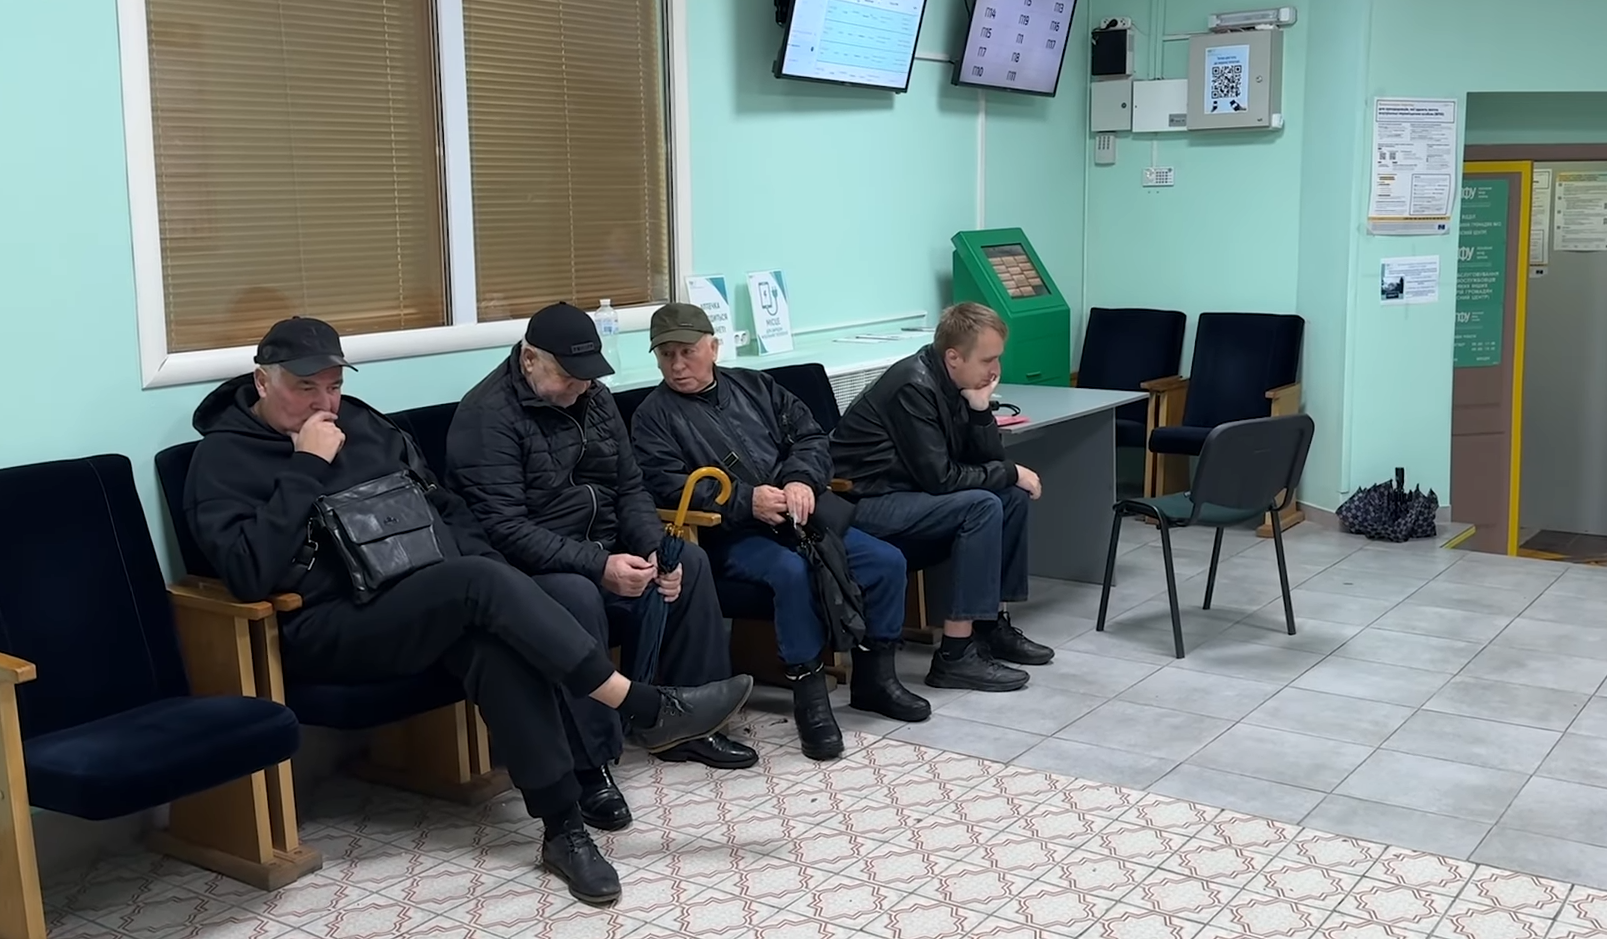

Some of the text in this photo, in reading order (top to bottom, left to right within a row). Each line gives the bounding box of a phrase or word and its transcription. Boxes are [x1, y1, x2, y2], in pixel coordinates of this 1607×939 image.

[984, 7, 997, 19] П14
[1018, 14, 1030, 26] П19
[980, 26, 992, 39] П15
[971, 65, 984, 77] П10
[1458, 246, 1475, 261] ФУ
